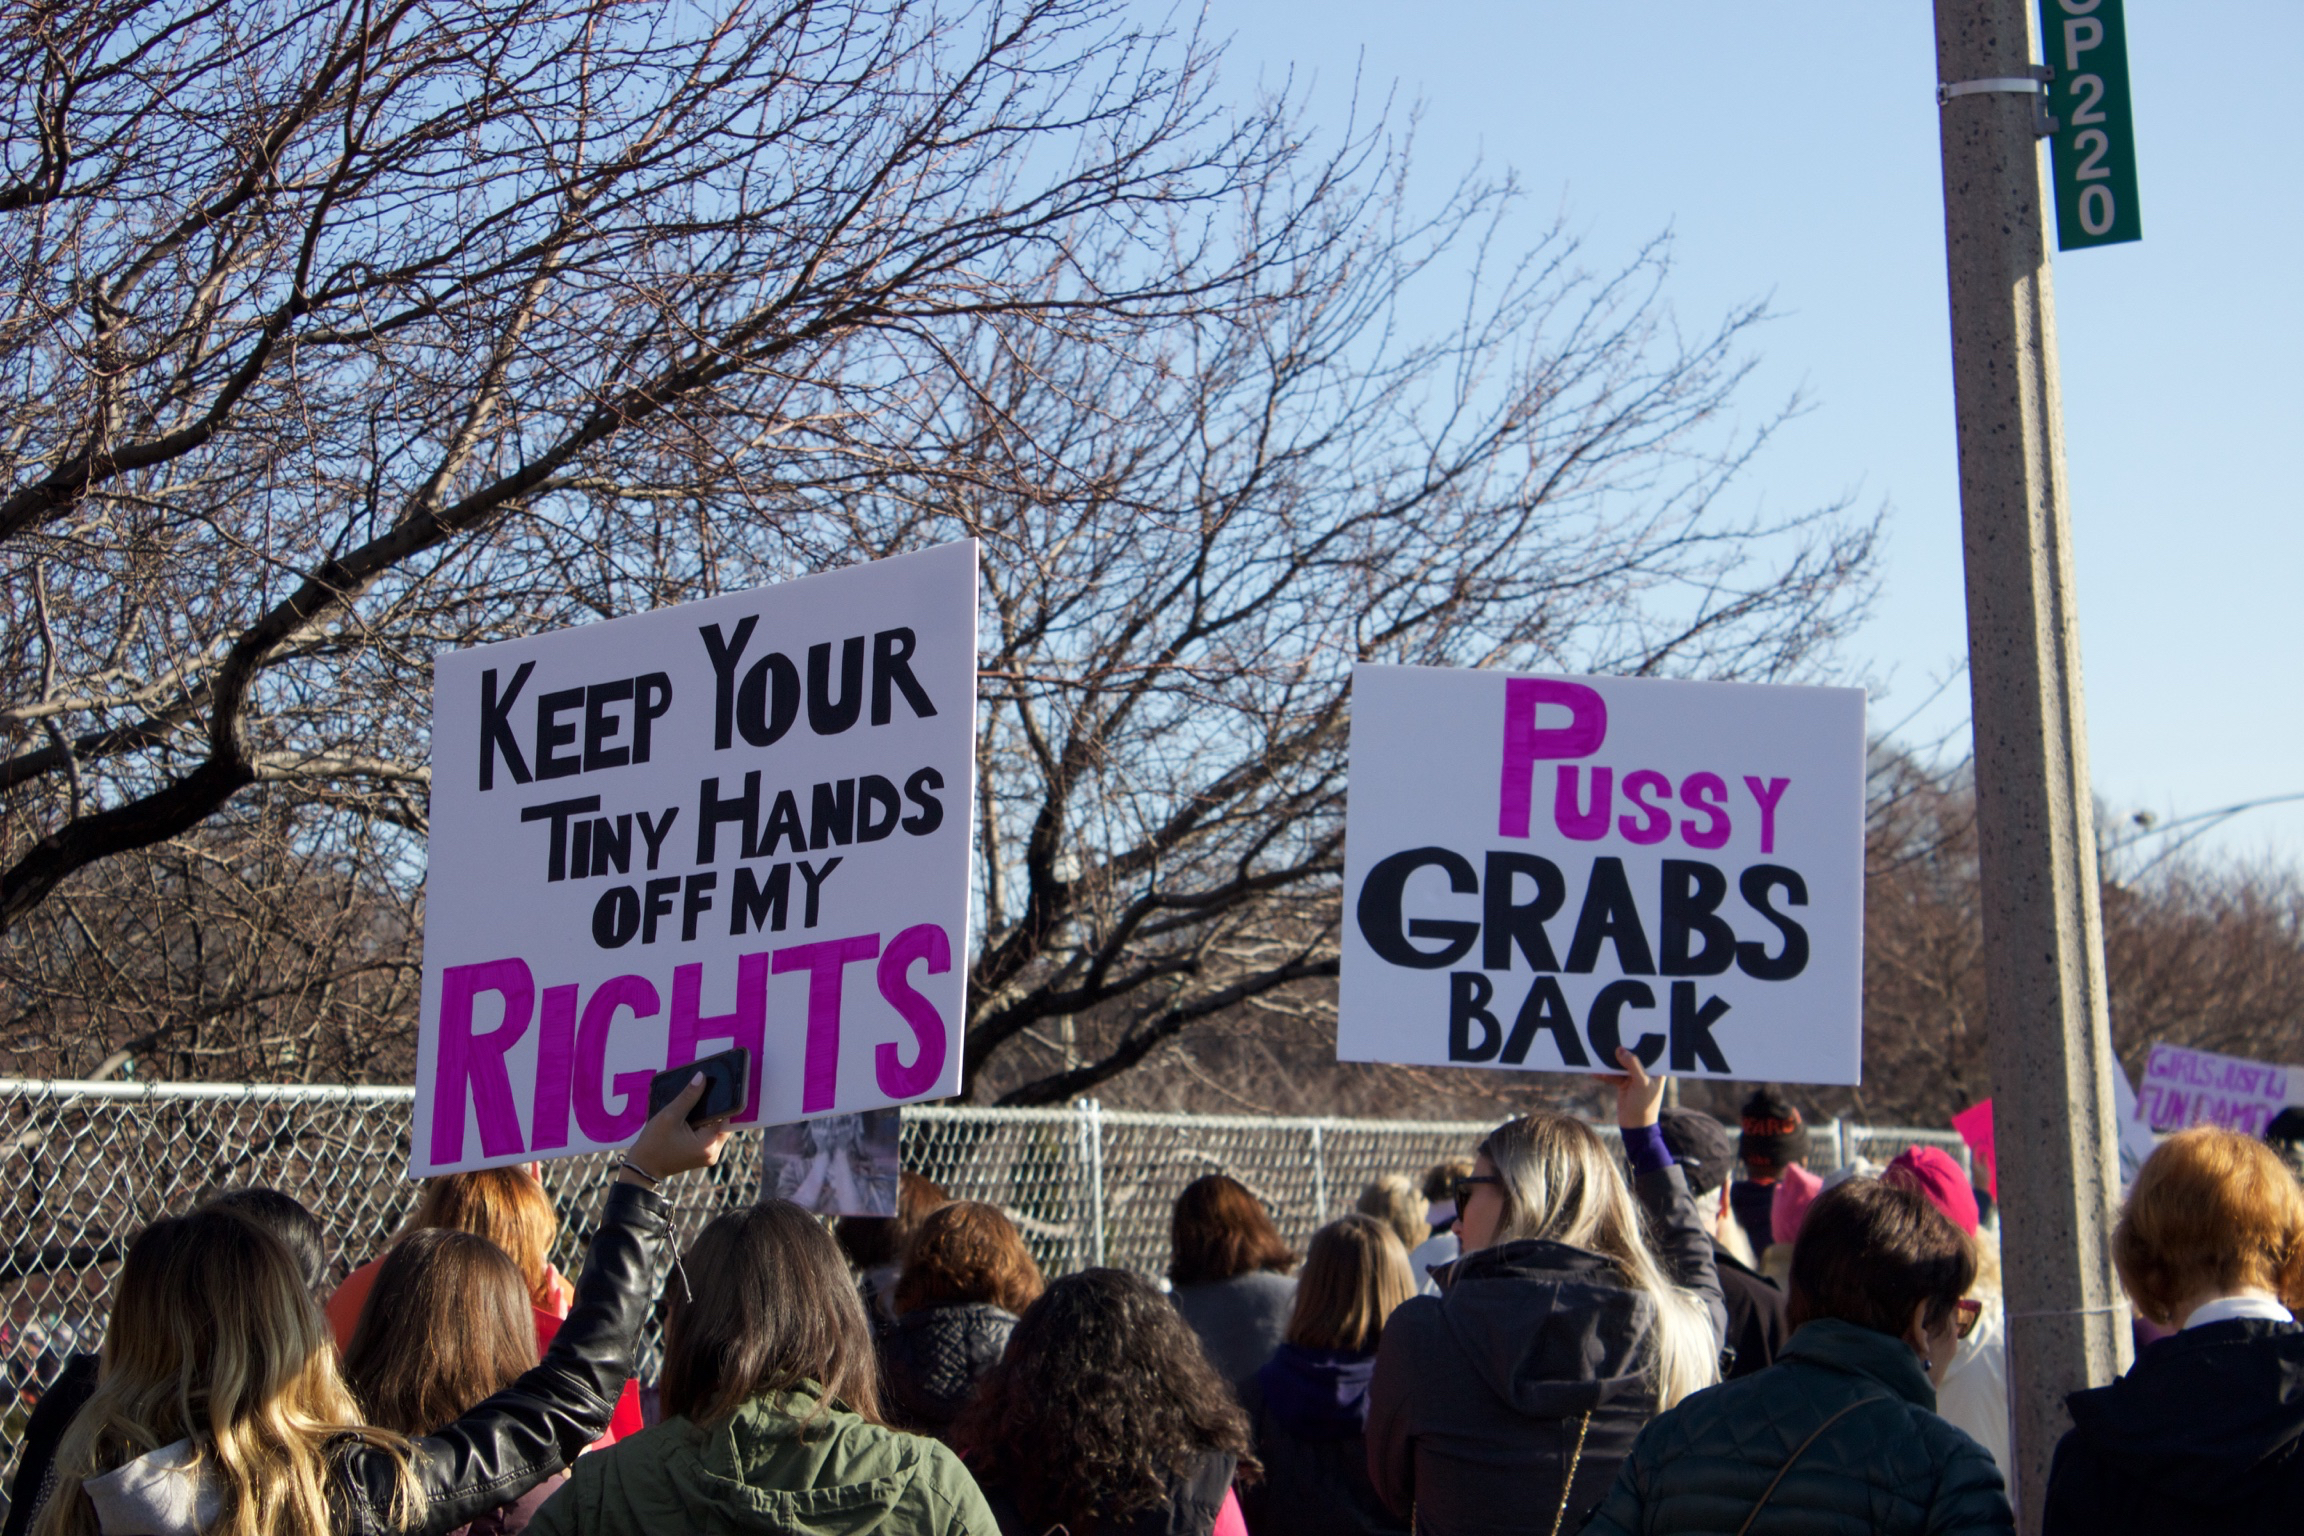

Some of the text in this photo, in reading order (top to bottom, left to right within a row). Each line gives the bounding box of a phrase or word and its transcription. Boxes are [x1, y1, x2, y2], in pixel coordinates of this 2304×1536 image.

[2058, 0, 2115, 236] P220
[479, 615, 937, 791] KEEP YOUR
[1499, 678, 1790, 853] PUSSY
[521, 767, 944, 882] TINY HANDS
[592, 857, 843, 949] OFF MY
[1357, 847, 1808, 980] GRABS
[430, 924, 951, 1165] RIGHTS
[1449, 972, 1731, 1073] BACK
[2149, 1046, 2216, 1087] GIRLS
[2215, 1061, 2264, 1095] JUST
